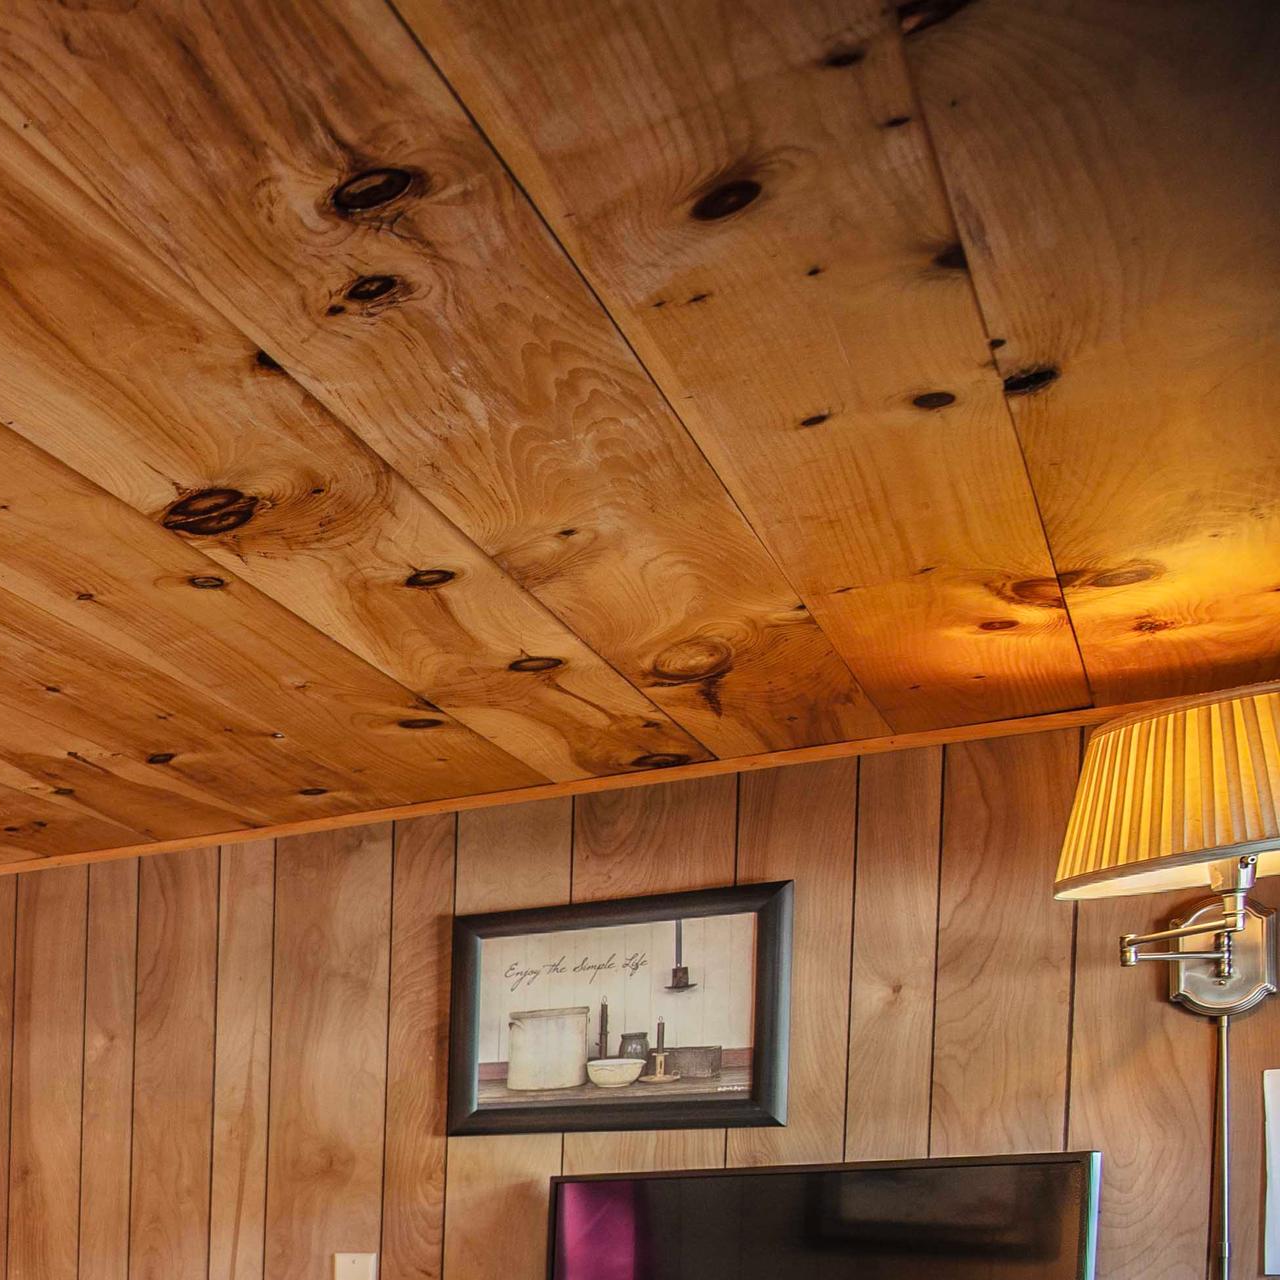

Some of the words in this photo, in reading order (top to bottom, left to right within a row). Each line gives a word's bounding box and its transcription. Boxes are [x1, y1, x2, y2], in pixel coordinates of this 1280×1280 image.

[505, 962, 540, 992] Enjoy
[573, 953, 616, 984] Simple
[622, 952, 648, 976] Life
